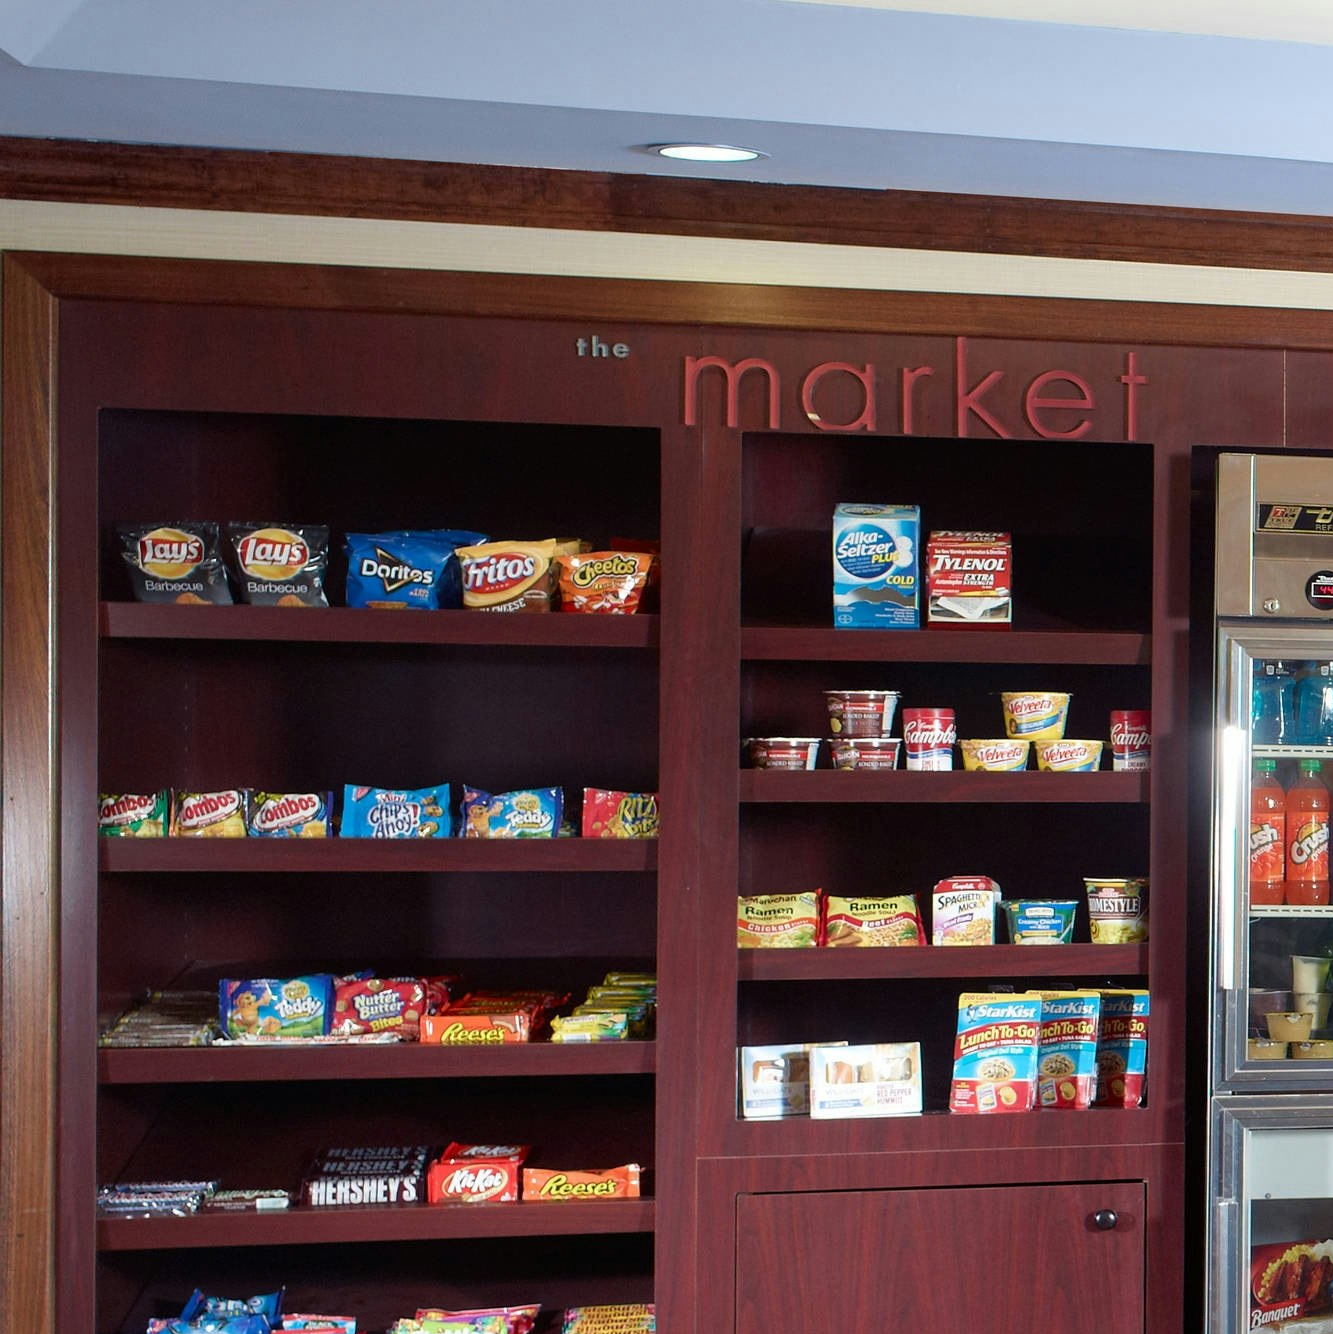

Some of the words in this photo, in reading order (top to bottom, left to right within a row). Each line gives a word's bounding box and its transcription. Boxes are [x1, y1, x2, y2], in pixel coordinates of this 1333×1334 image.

[577, 335, 631, 358] the
[685, 336, 1150, 441] market
[143, 539, 201, 565] Lay's
[245, 540, 306, 566] Lay's
[837, 542, 893, 559] Seltzer
[362, 559, 433, 584] Doritos
[933, 555, 1006, 571] TYLENOL
[463, 555, 534, 590] Fritos
[573, 557, 636, 587] Cheetos
[886, 576, 915, 585] COLD
[145, 580, 203, 592] Barbecue
[247, 582, 308, 593] Barbecue
[1009, 699, 1052, 714] Velveeta
[980, 747, 1023, 762] Velveeta
[1045, 747, 1088, 762] Velveeta
[102, 795, 156, 818] ombos
[370, 804, 410, 824] Chips
[505, 811, 552, 828] Teddy
[745, 905, 794, 917] Ramen
[850, 902, 898, 912] Ramen
[748, 922, 791, 933] Chicken
[354, 991, 399, 1008] Nutter
[1043, 1001, 1094, 1015] StarKist
[275, 998, 322, 1019] Teddy
[358, 1001, 404, 1019] Butter
[979, 1005, 1036, 1019] StarKist
[370, 1017, 403, 1031] Bites
[441, 1022, 505, 1042] Reese's
[311, 1176, 417, 1205] HERSHEY'S
[540, 1174, 617, 1197] Reese's
[1251, 1303, 1301, 1329] Banquet
